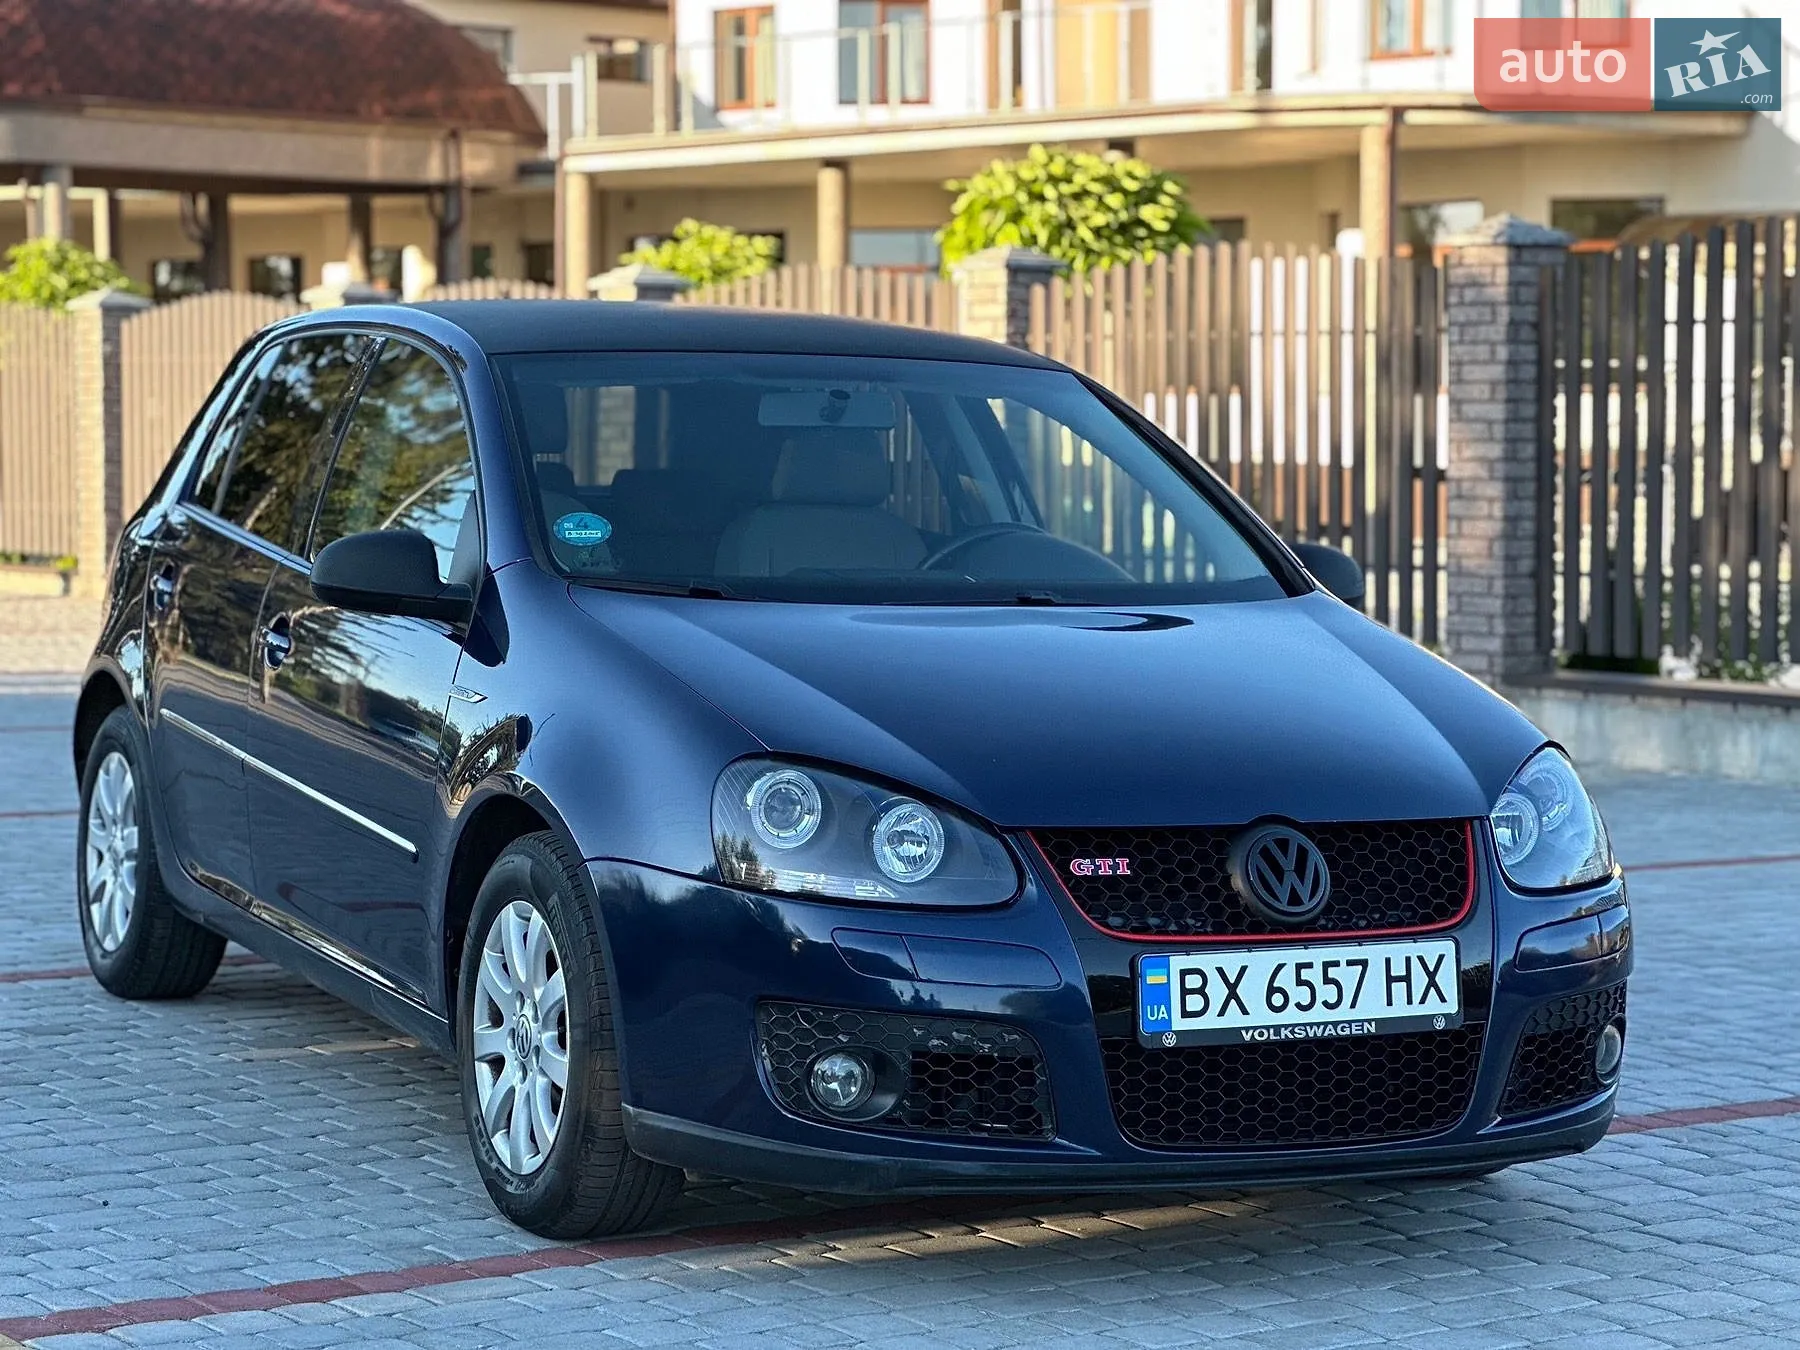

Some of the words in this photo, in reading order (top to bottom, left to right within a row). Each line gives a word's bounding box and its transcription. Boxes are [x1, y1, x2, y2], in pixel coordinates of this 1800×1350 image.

[1070, 858, 1131, 876] GTI
[1178, 964, 1250, 1019] BX
[1265, 958, 1369, 1014] 6557
[1385, 953, 1448, 1007] HX
[1147, 1006, 1169, 1020] UA
[1240, 1020, 1376, 1042] VOLKSWAGEN
